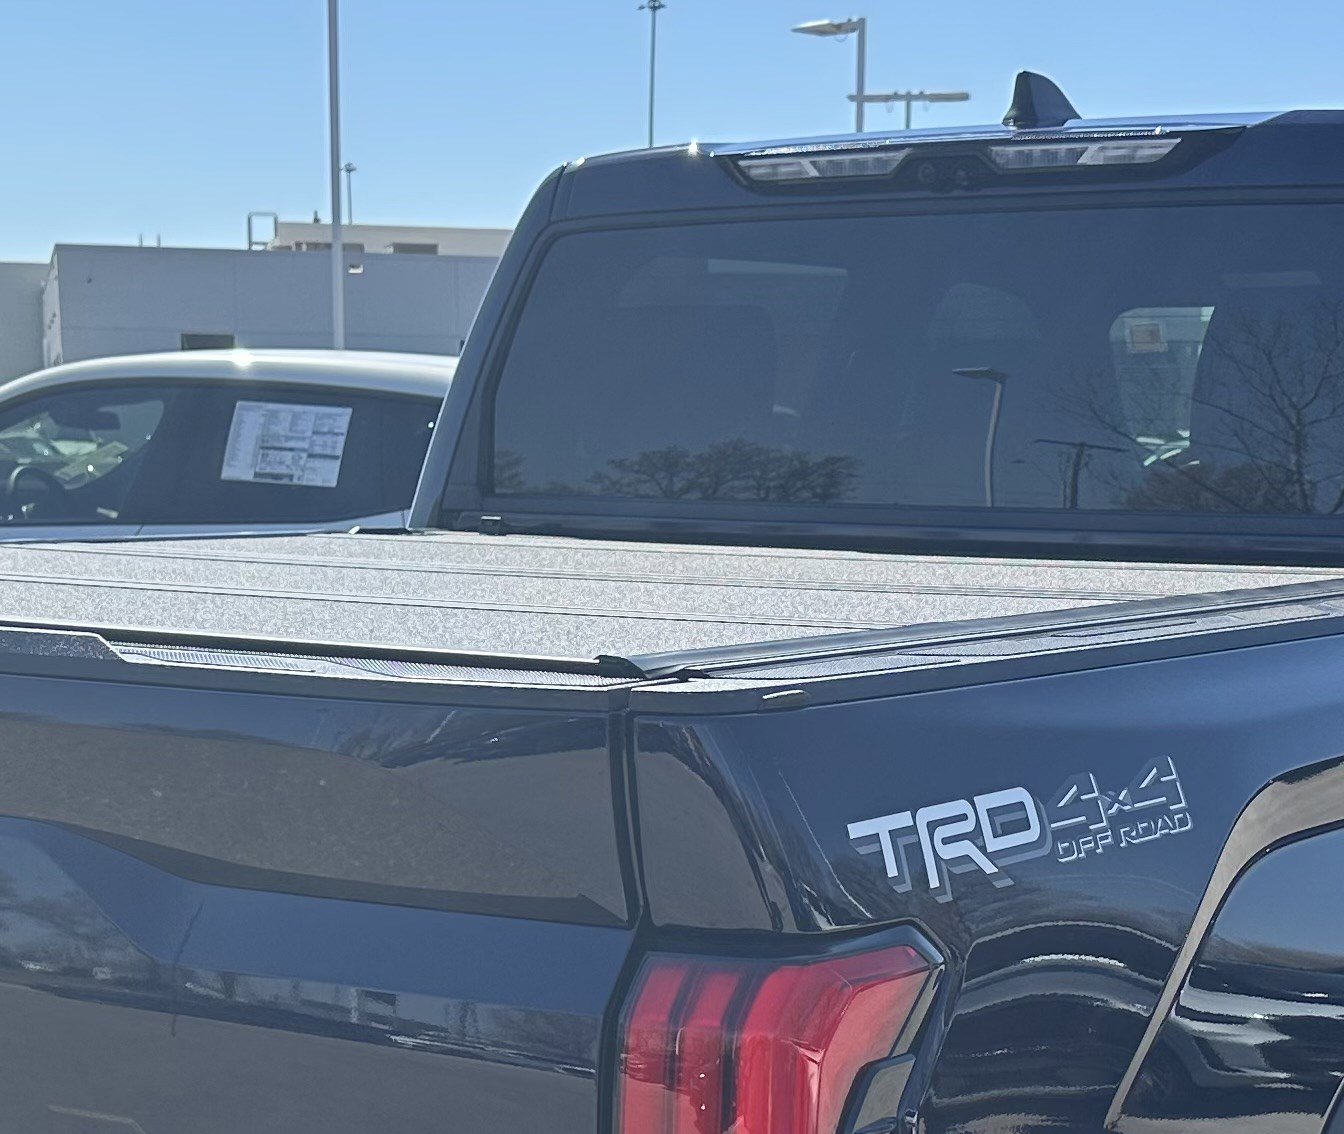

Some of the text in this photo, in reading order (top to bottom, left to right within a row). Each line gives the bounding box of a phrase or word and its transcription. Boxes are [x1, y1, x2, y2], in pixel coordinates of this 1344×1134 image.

[847, 754, 1189, 893] TRD 4x4
[1057, 811, 1193, 863] OFF ROAD
